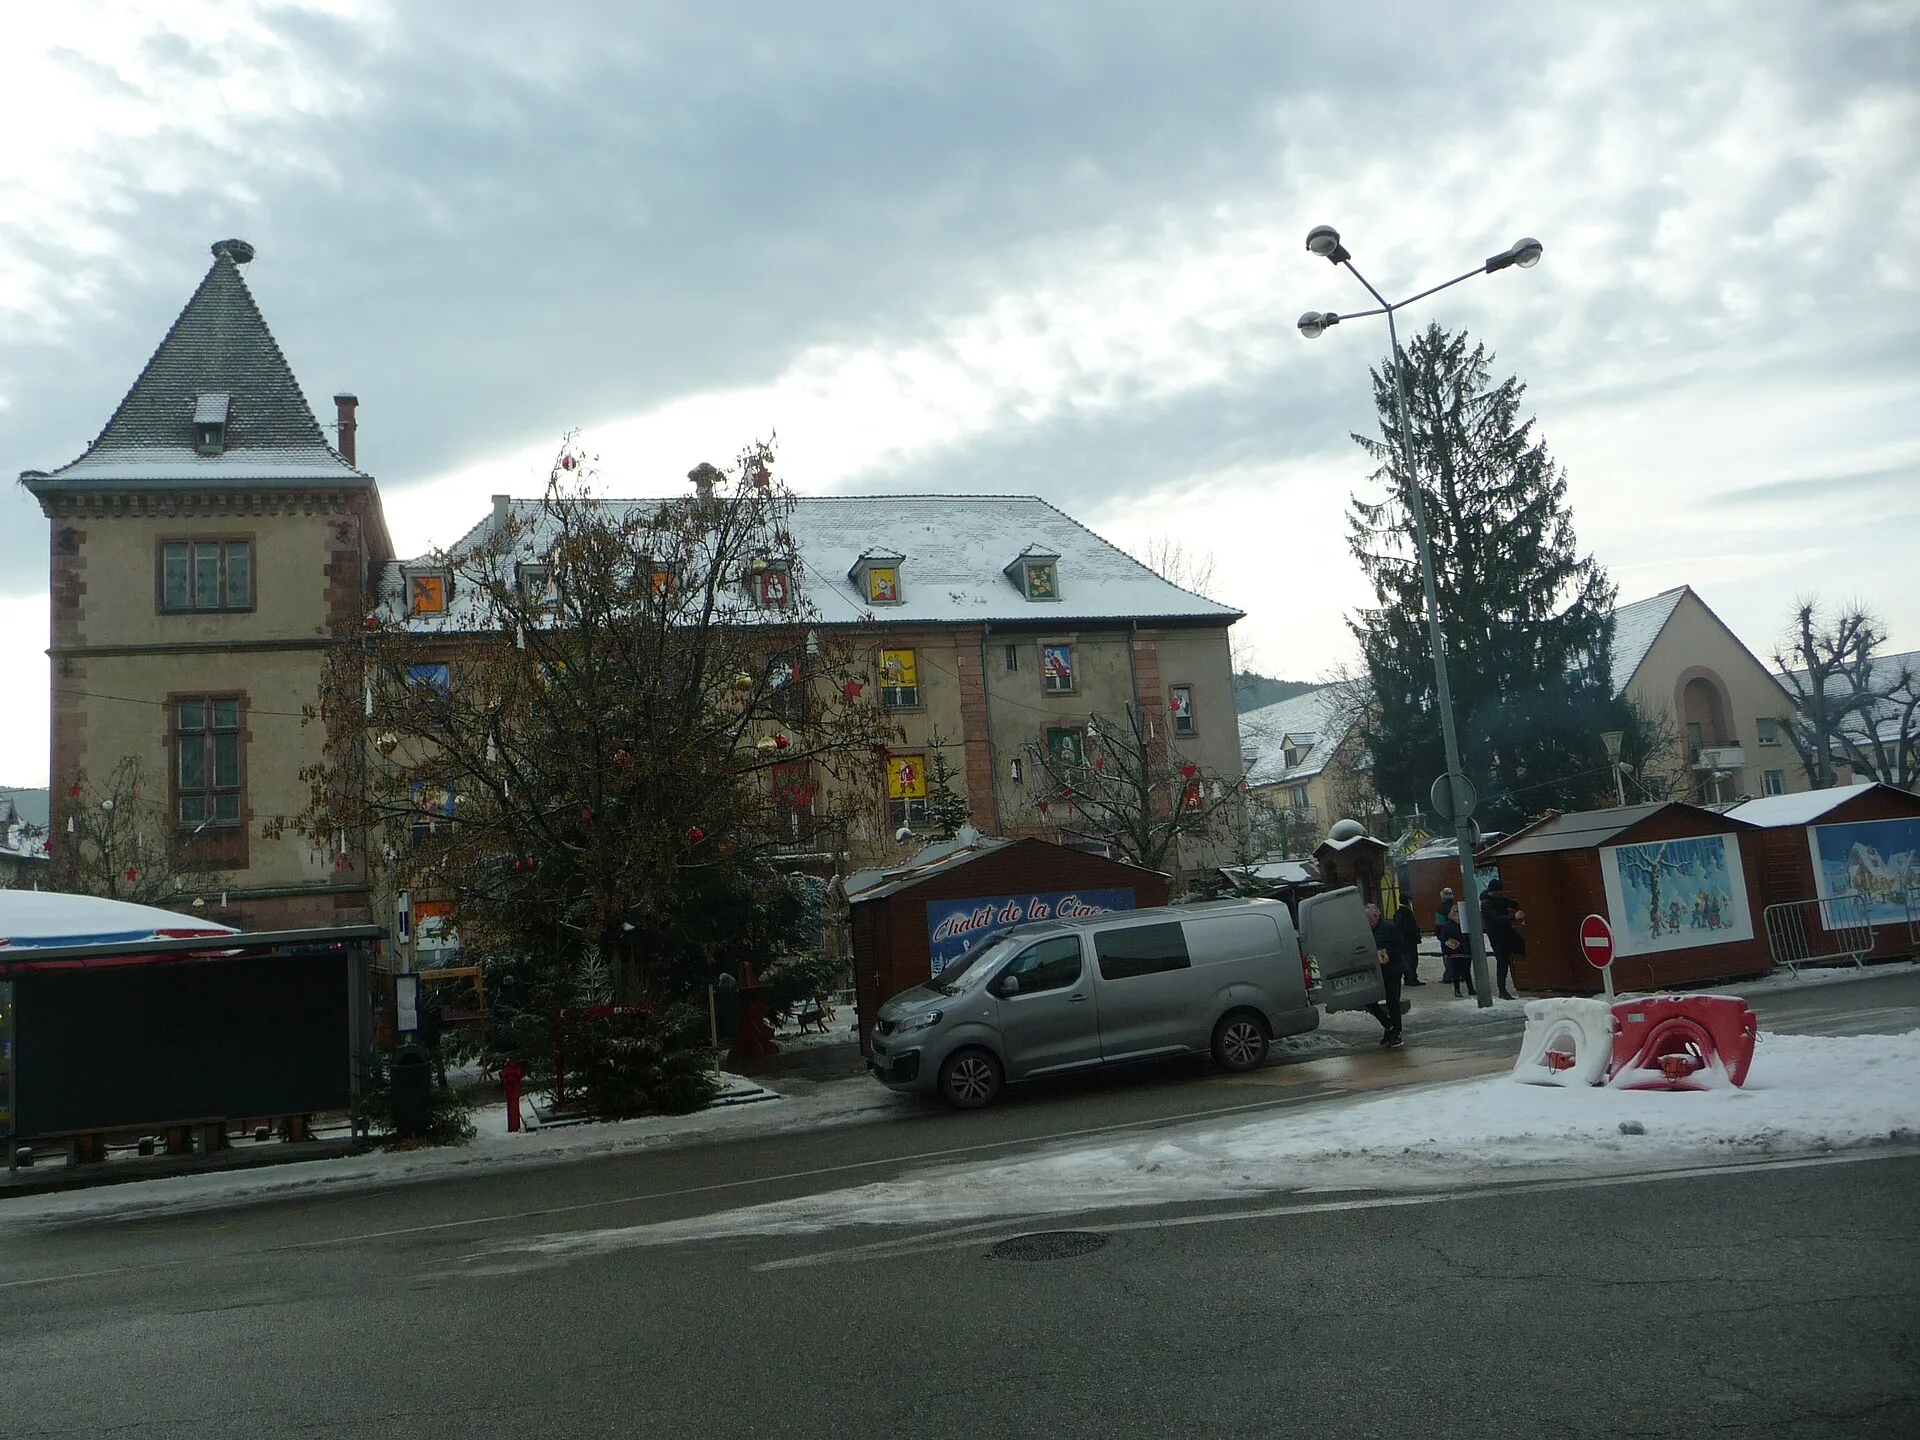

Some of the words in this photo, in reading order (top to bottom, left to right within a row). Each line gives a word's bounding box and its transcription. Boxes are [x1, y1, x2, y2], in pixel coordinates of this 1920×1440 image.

[933, 904, 997, 942] Chalet
[998, 899, 1022, 922] de
[1028, 897, 1051, 919] la
